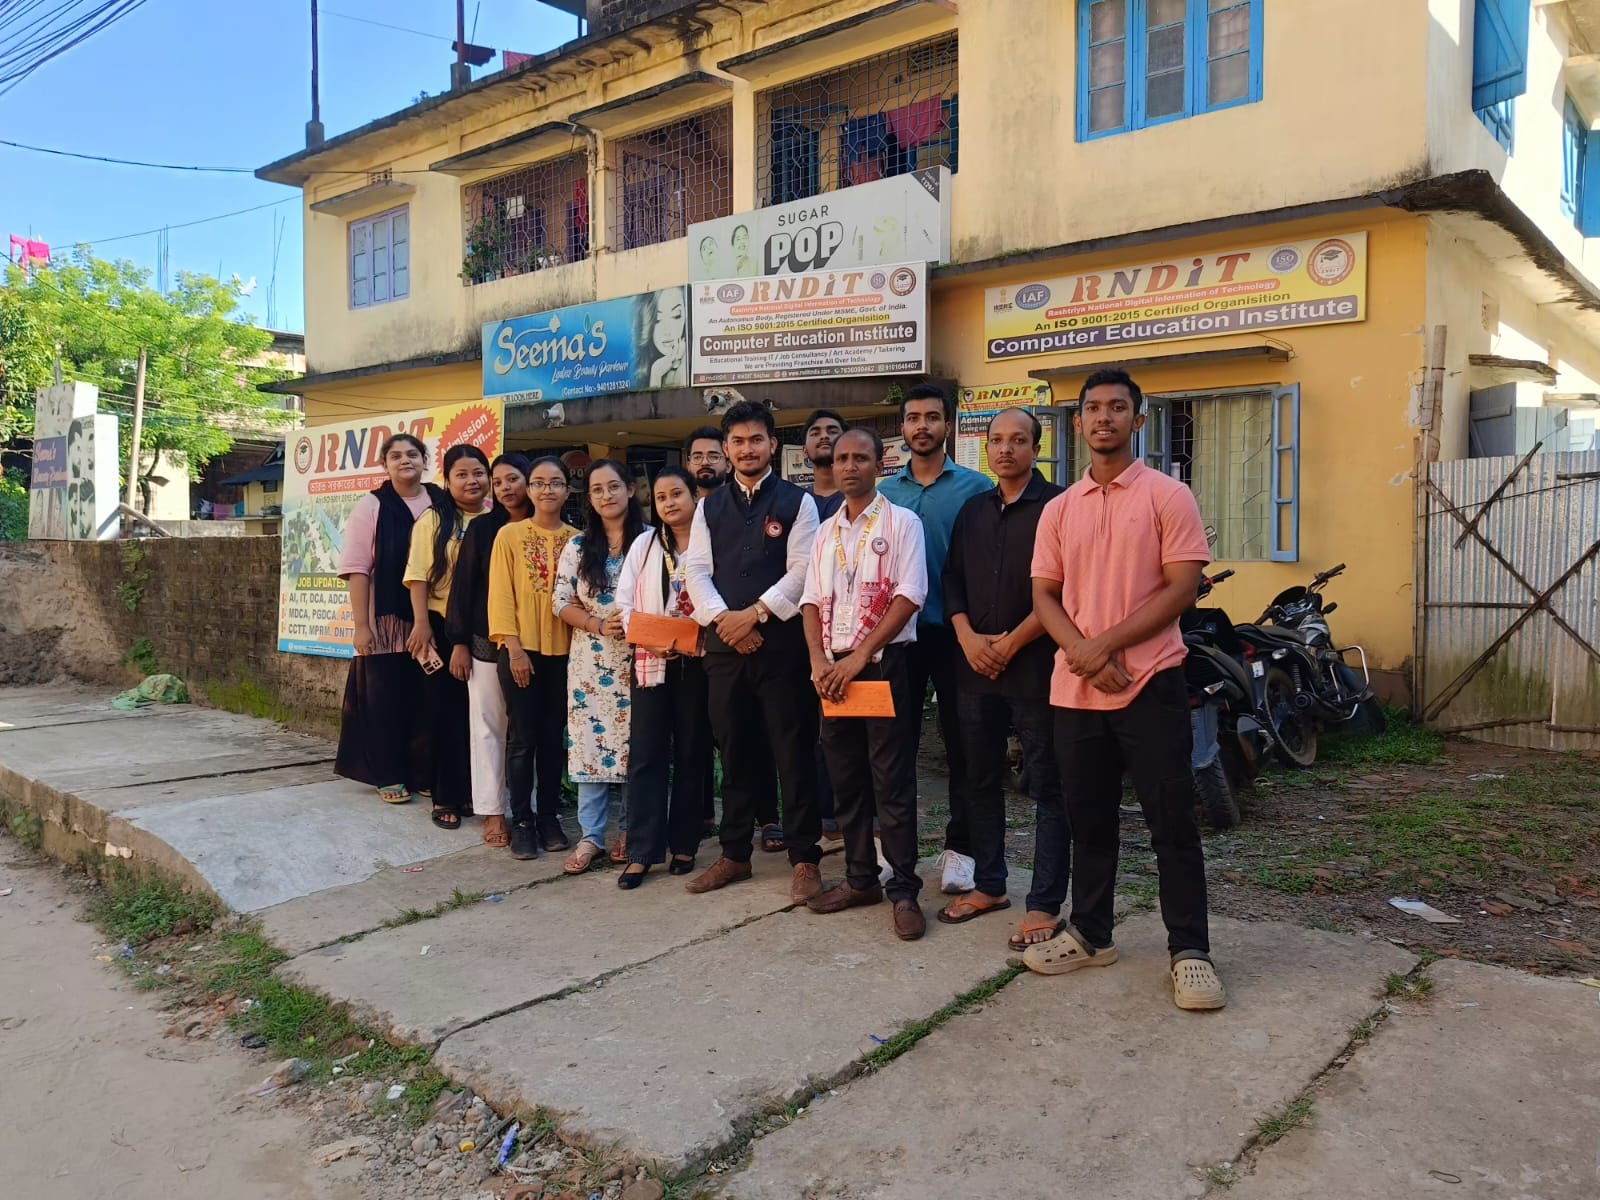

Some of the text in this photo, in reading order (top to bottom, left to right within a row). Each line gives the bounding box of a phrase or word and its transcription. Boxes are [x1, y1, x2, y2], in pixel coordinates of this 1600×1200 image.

[778, 205, 829, 227] SUGAR
[764, 221, 844, 275] POP
[1276, 254, 1294, 263] ISO
[722, 288, 740, 298] IAF
[1022, 290, 1044, 303] IAF
[1047, 304, 1086, 317] Rashtriya
[1087, 301, 1122, 311] National
[1125, 297, 1153, 307] Digital
[1155, 290, 1206, 303] Information
[1222, 280, 1276, 294] Technology
[775, 311, 811, 320] Registered
[812, 309, 833, 317] Under
[1035, 292, 1291, 332] An ISO 9001:2015 Certified Organisition
[724, 313, 890, 332] An ISO 9001:2015 Certified Organisition
[990, 300, 1353, 353] Computer Education Institute
[703, 325, 913, 353] Computer Education Institute
[791, 351, 827, 360] Consultancy
[844, 347, 872, 356] Academy
[573, 363, 598, 379] Beauty
[960, 414, 995, 424] Admiss
[314, 417, 434, 473] RNDT
[297, 576, 346, 589] JOB UPDATES
[309, 593, 326, 605] DCA,
[289, 608, 310, 620] MDCA,
[288, 624, 307, 635] CCTT,
